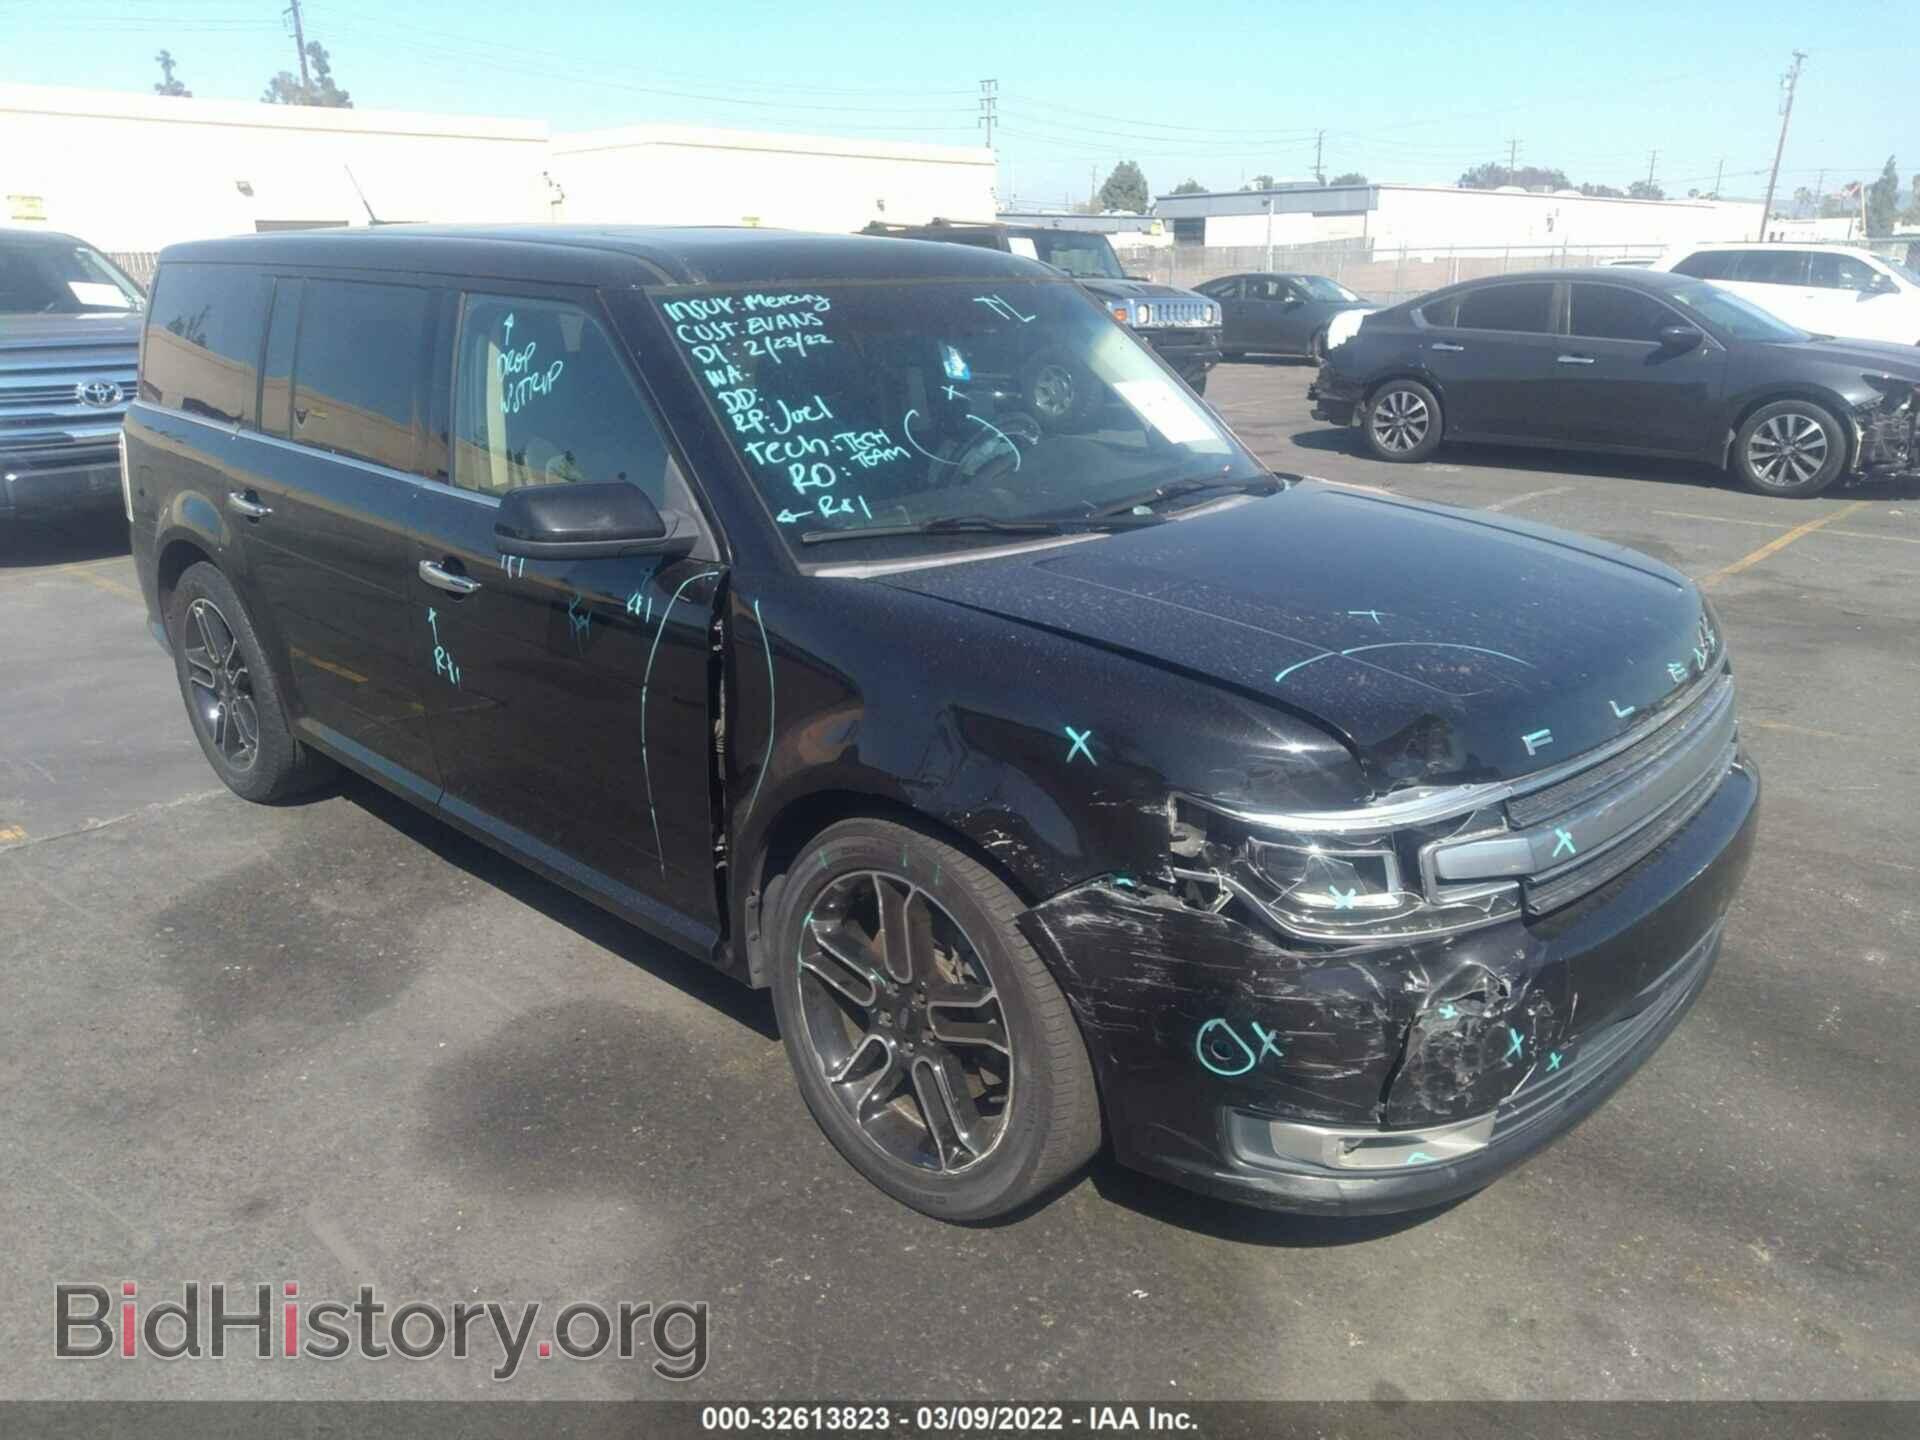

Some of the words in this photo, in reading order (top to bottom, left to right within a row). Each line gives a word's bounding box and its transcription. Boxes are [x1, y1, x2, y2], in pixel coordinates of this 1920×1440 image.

[743, 293, 831, 312] Mercury
[745, 312, 824, 335] EVANS
[496, 341, 537, 378] DROP
[743, 331, 834, 364] 2/23/22
[704, 364, 752, 388] WA:
[717, 388, 764, 415] DD:
[832, 428, 892, 453] TECH
[849, 446, 912, 469] TEAM
